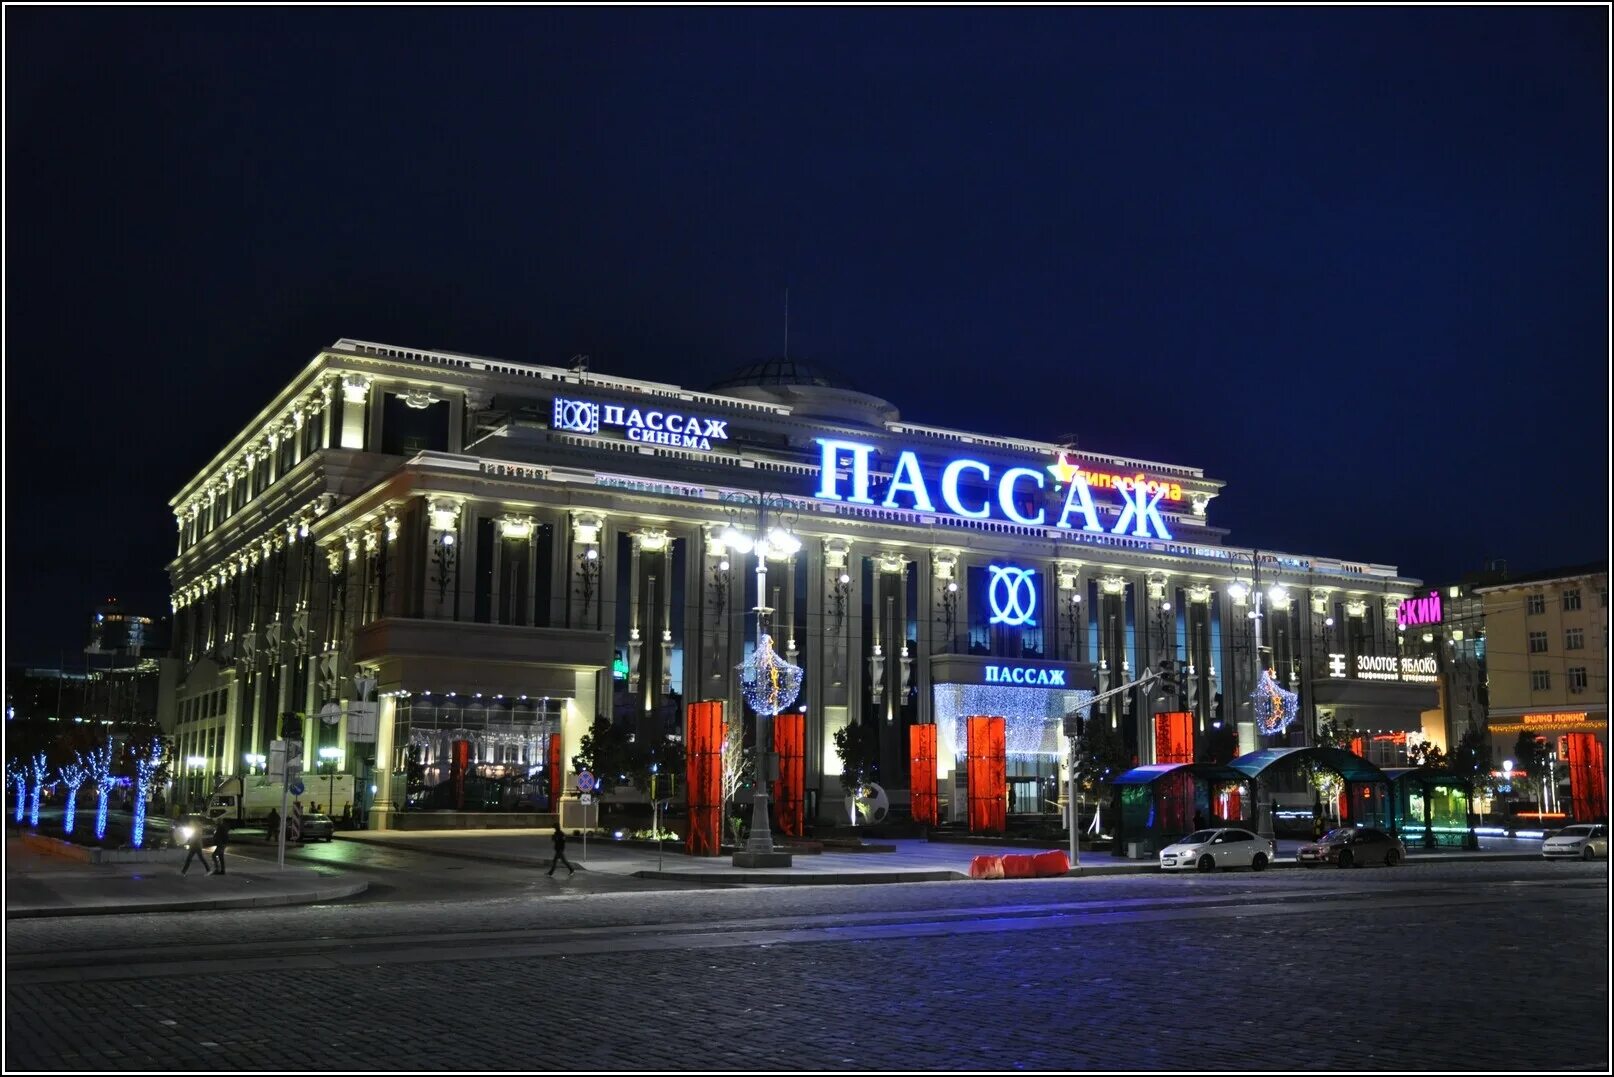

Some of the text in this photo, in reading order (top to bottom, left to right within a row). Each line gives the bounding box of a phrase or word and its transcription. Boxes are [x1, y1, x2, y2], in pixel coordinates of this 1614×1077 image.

[604, 405, 728, 440] ПАССАЖ
[628, 427, 711, 450] СИНЕМА
[815, 438, 1173, 540] ПАССАЖ
[1397, 591, 1441, 625] СКИЙ
[985, 665, 1066, 686] ПАССАЖ
[1357, 655, 1437, 674] ЗОЛОТОЕ ЯБЛОКО
